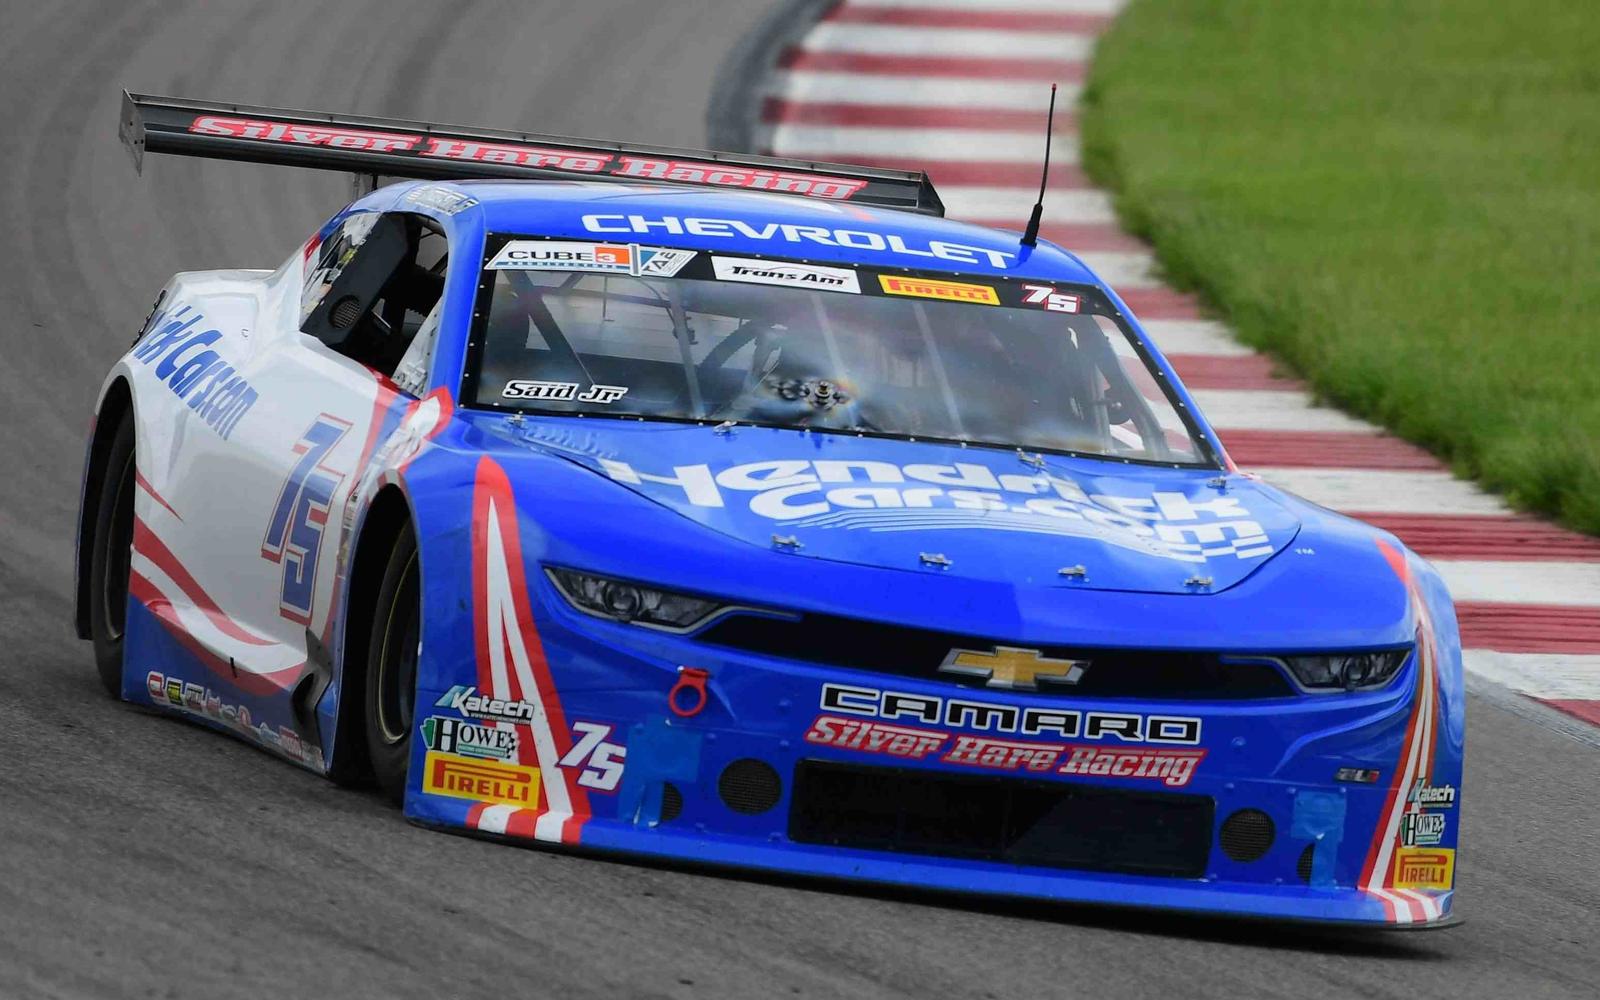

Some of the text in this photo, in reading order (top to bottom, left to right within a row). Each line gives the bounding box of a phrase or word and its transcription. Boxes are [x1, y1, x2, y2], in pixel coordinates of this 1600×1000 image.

[190, 116, 867, 199] Silver Hare Racing
[581, 214, 1016, 269] CHEVROLET
[731, 265, 845, 286] Trans Am
[887, 278, 991, 301] PIRELLI
[1022, 284, 1079, 313] 75
[503, 380, 628, 403] Said Jr
[598, 459, 1250, 521] Hendrick
[262, 413, 352, 624] 75
[450, 686, 534, 719] Katech
[820, 683, 1202, 745] CAMARO
[433, 717, 510, 754] HOWE
[806, 716, 1206, 788] Silver Hare Racing
[558, 721, 627, 793] 75
[431, 758, 531, 802] PIRELLI
[1414, 778, 1456, 808] Katech
[1405, 813, 1443, 846] HOWE
[1398, 854, 1448, 883] PIRELLI
